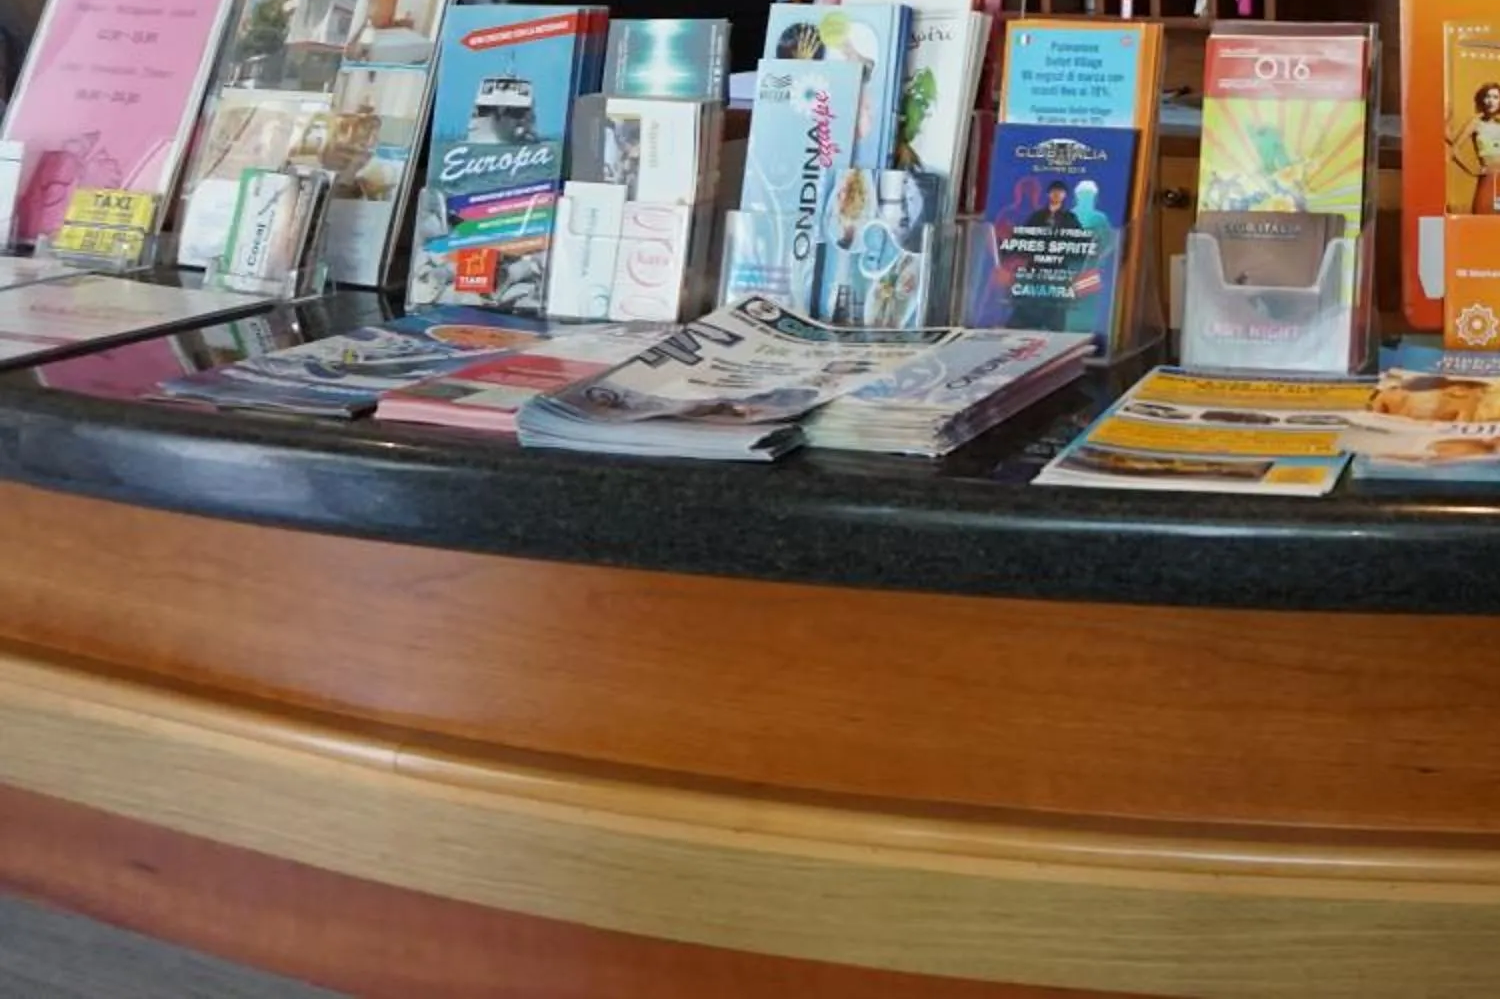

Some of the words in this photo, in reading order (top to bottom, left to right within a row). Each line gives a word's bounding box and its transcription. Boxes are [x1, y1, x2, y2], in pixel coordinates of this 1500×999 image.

[439, 145, 554, 181] Europa
[93, 192, 135, 211] TAXI
[792, 124, 822, 262] ONDINA
